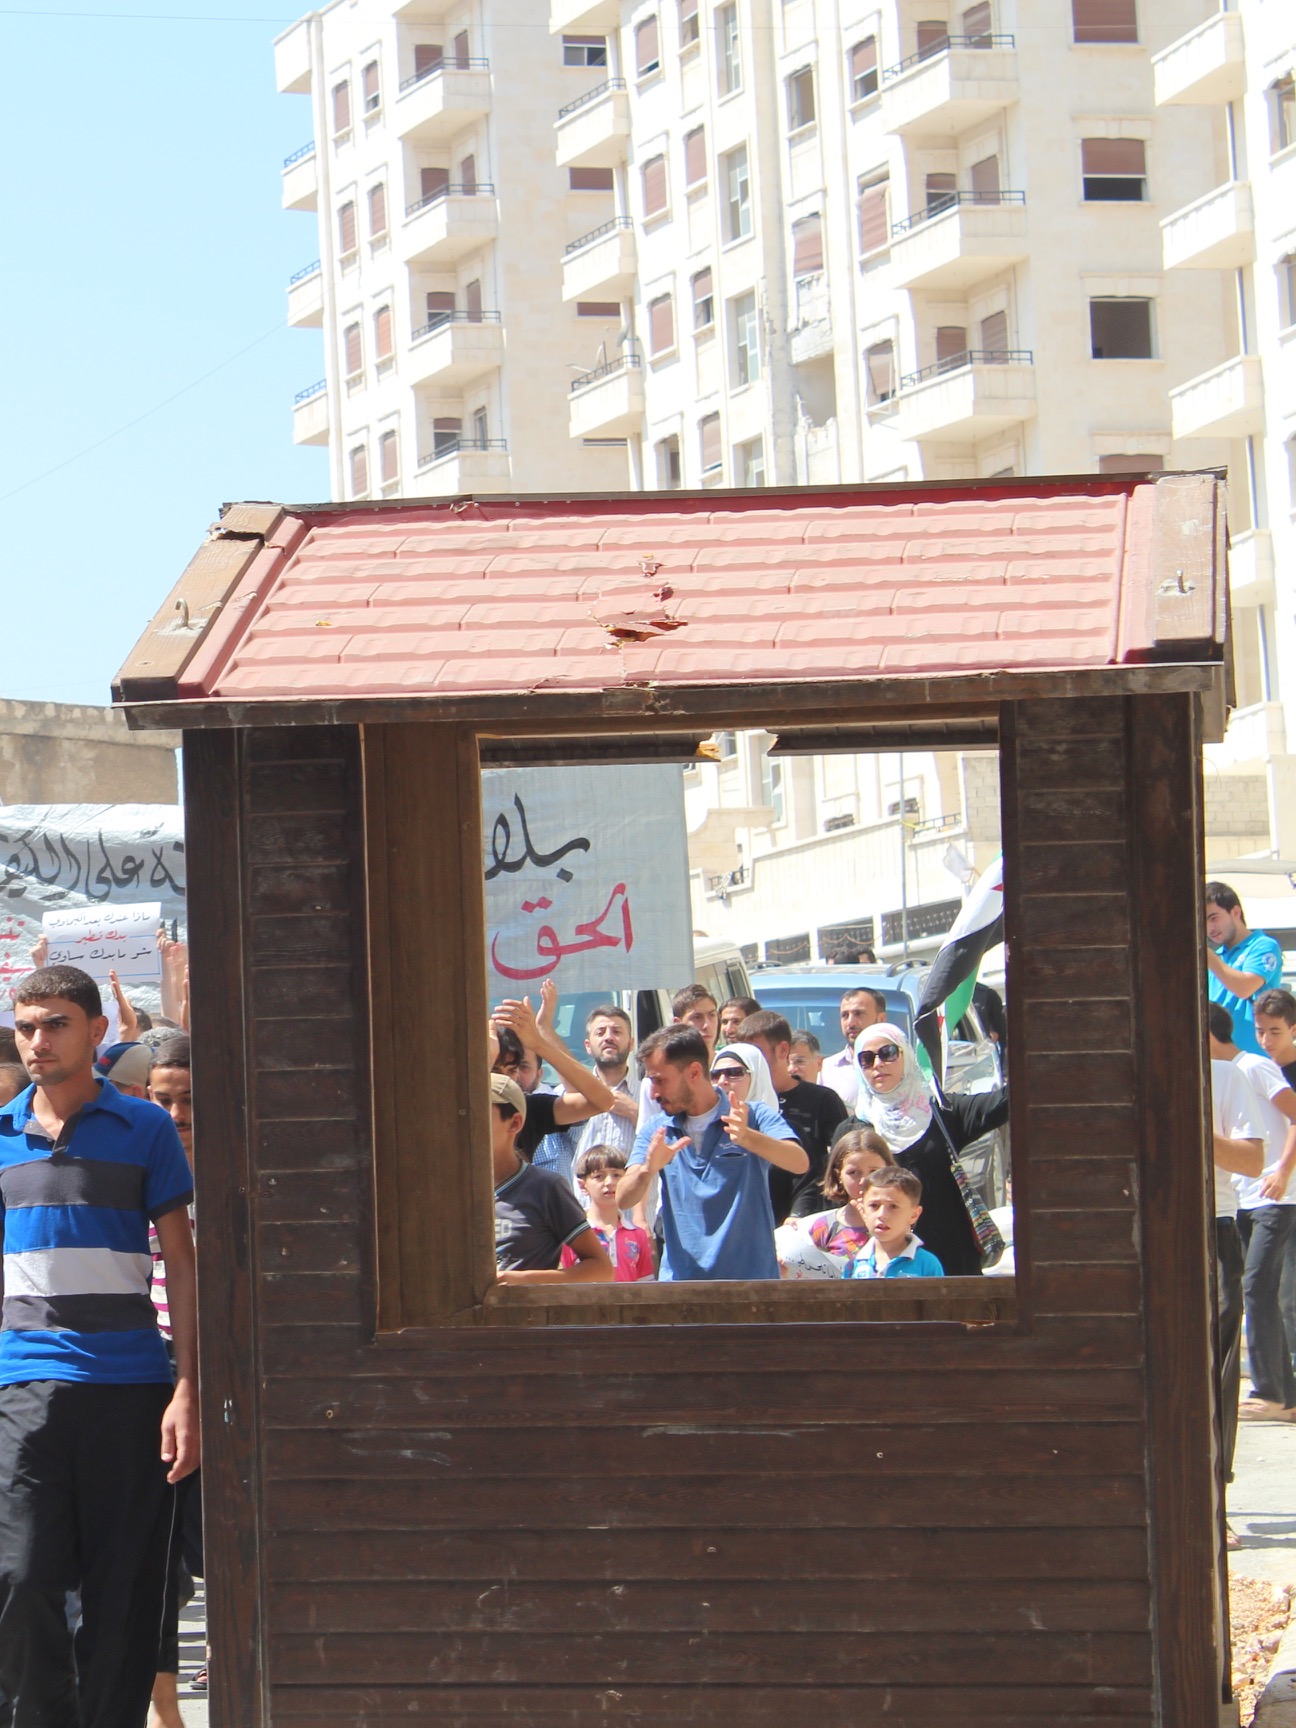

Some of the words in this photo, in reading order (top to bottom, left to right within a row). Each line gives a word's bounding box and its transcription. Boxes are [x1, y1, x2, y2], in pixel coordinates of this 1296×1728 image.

[85, 831, 144, 903] على
[485, 793, 590, 882] بلا
[104, 929, 127, 943] بدك
[133, 911, 151, 922] ماذا
[492, 882, 633, 980] الحق
